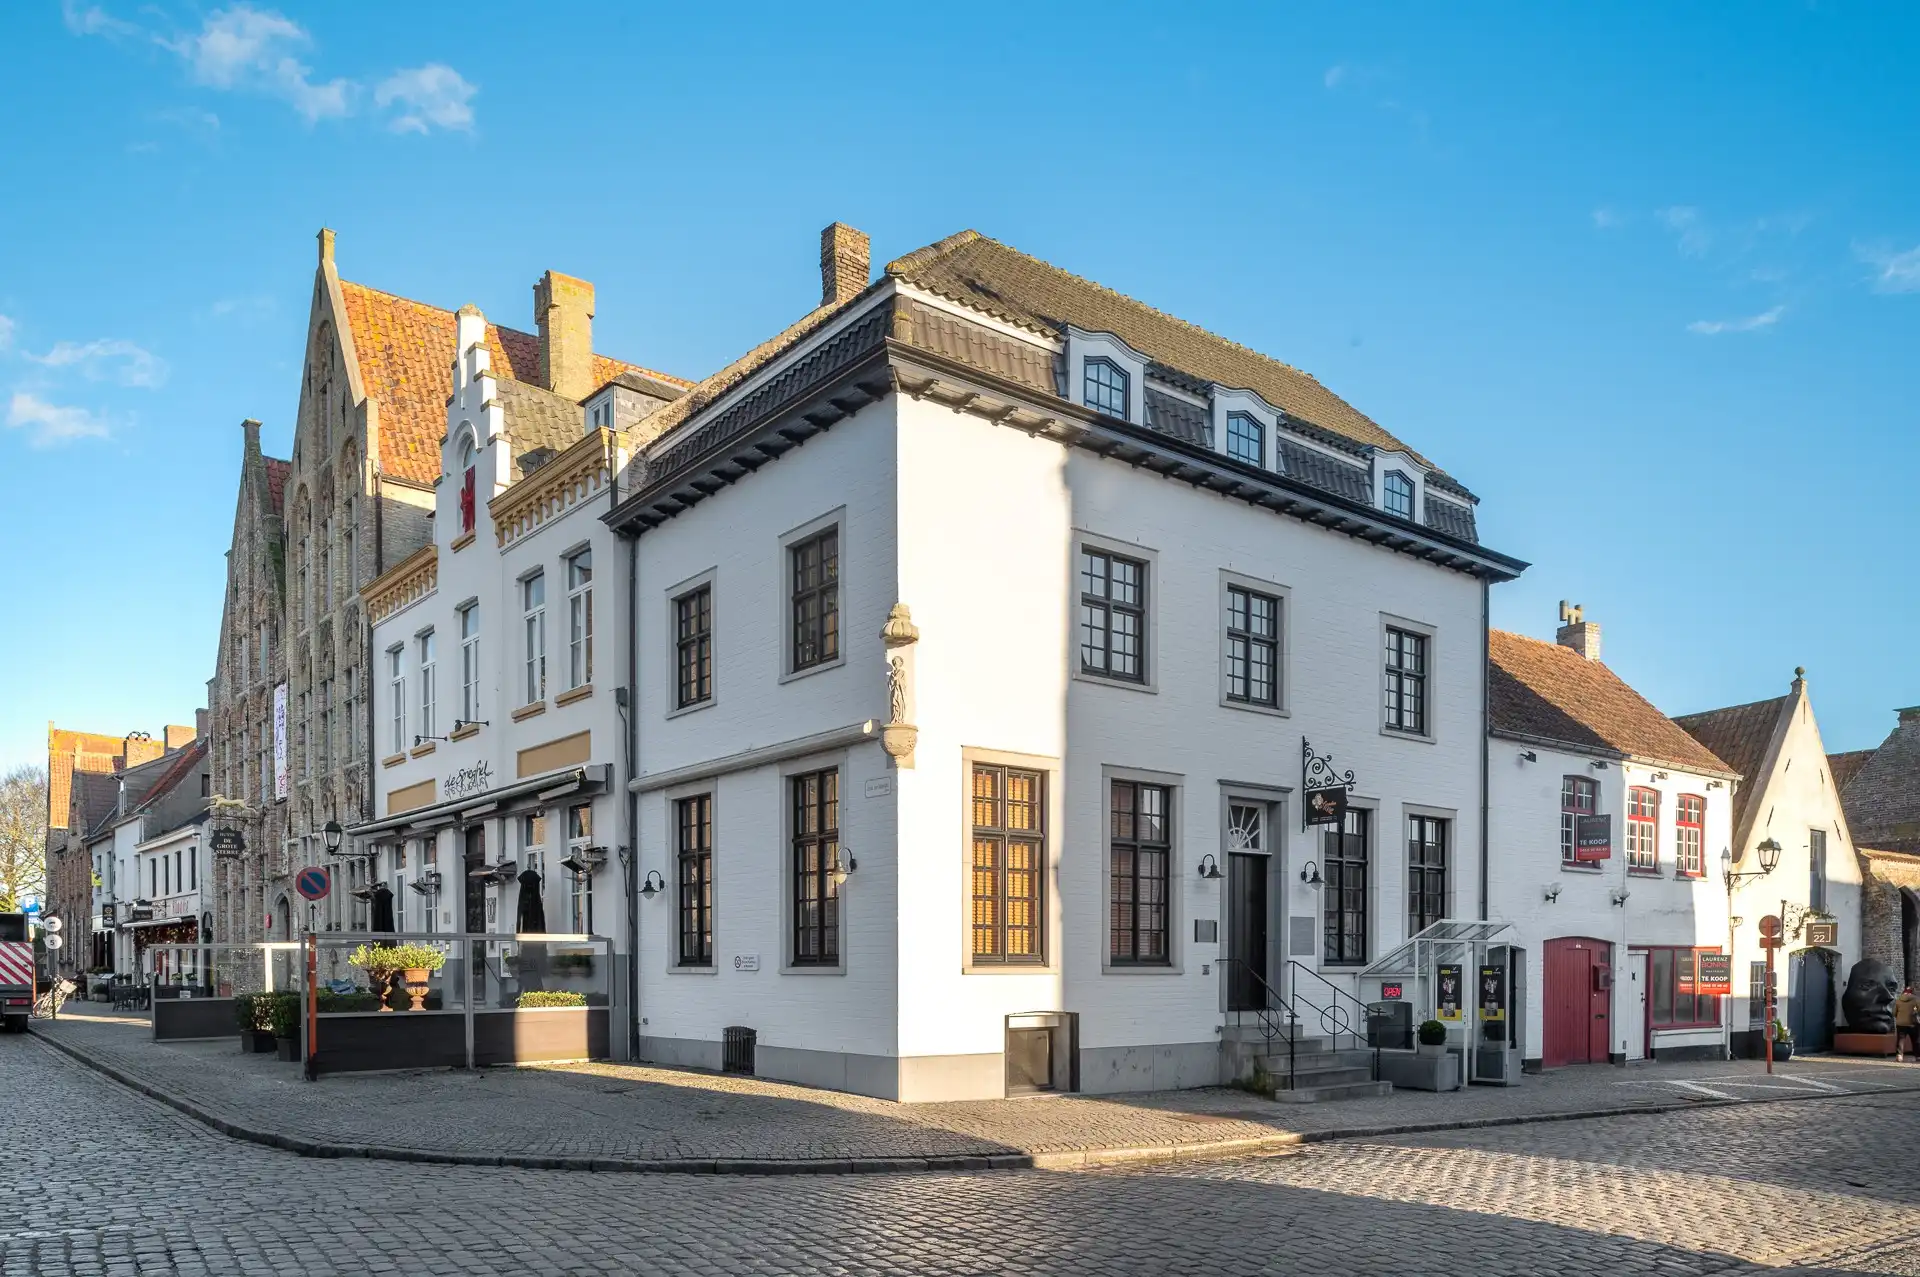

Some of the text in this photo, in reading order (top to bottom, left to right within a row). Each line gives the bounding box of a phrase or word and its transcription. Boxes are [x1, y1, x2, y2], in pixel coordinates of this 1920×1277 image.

[1589, 838, 1608, 846] KOOP
[1813, 934, 1826, 943] 22
[1384, 987, 1401, 997] OPEN
